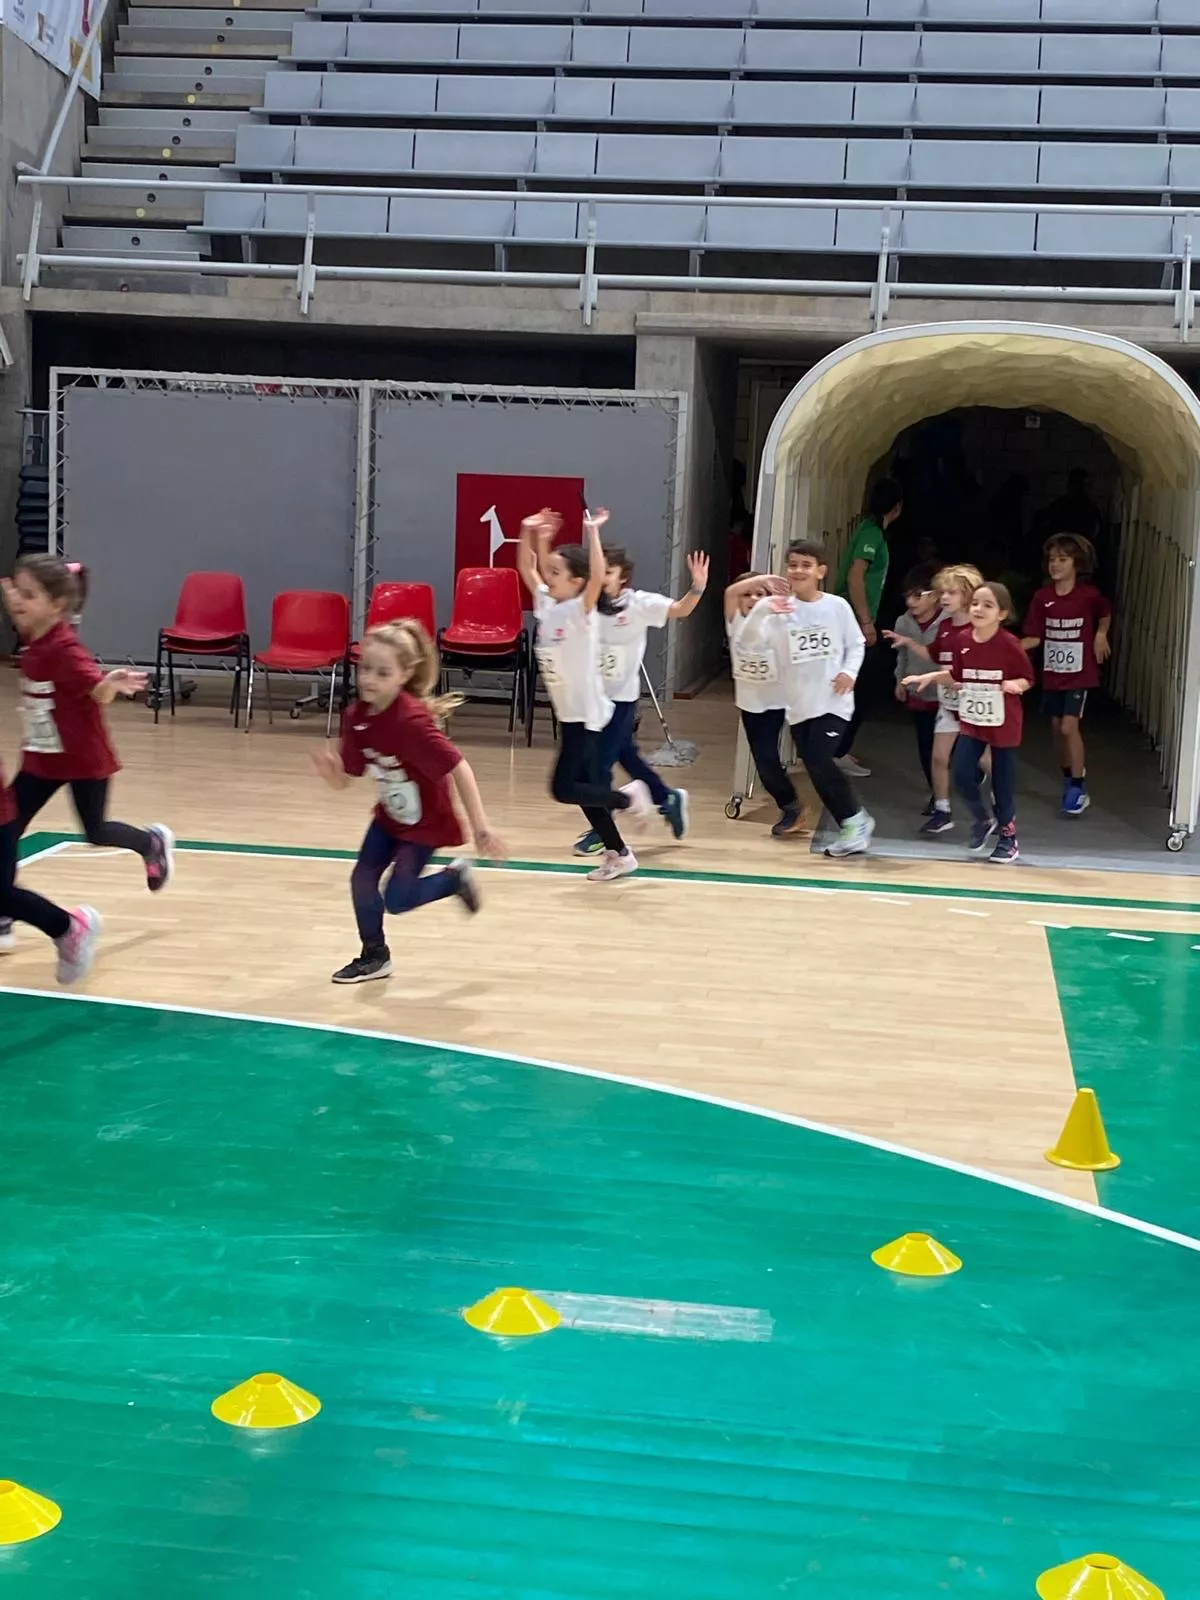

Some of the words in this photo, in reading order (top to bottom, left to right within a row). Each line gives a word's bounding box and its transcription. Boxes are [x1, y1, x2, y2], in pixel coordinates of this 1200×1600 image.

[798, 632, 831, 651] 256
[1048, 649, 1075, 664] 206
[739, 660, 770, 674] 255
[966, 699, 995, 715] 201
